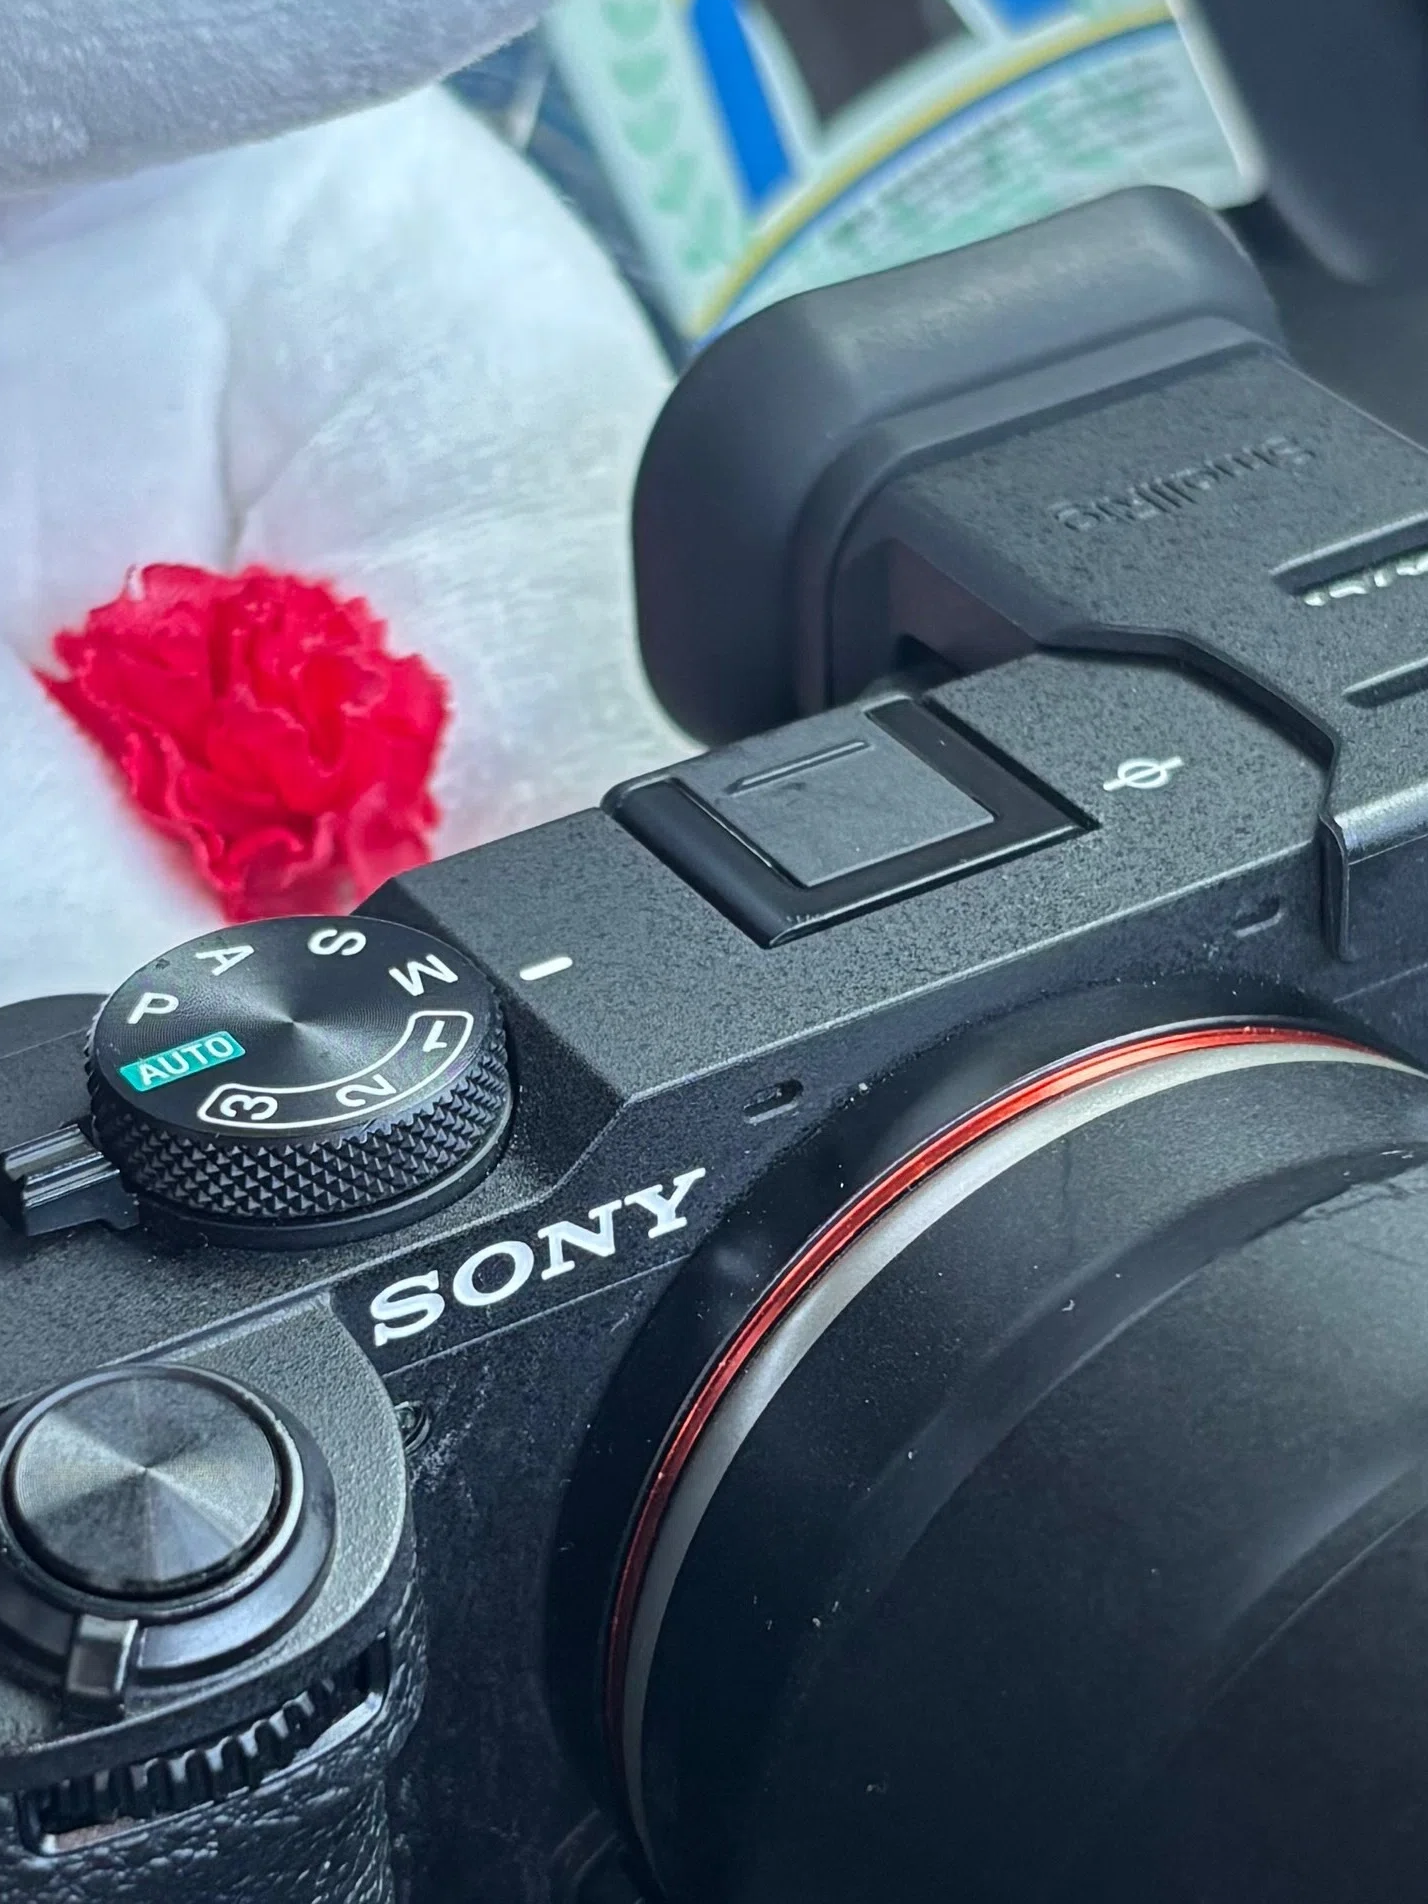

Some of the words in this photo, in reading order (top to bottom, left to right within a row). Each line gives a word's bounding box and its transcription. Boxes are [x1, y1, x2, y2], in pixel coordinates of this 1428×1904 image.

[307, 928, 367, 956] S
[192, 944, 255, 977] A
[388, 953, 459, 997] M
[127, 991, 180, 1025] P
[421, 1019, 450, 1053] 1
[137, 1034, 235, 1088] AUTO
[220, 1093, 278, 1122] 3
[335, 1072, 393, 1109] 2
[369, 1166, 706, 1347] SONY
